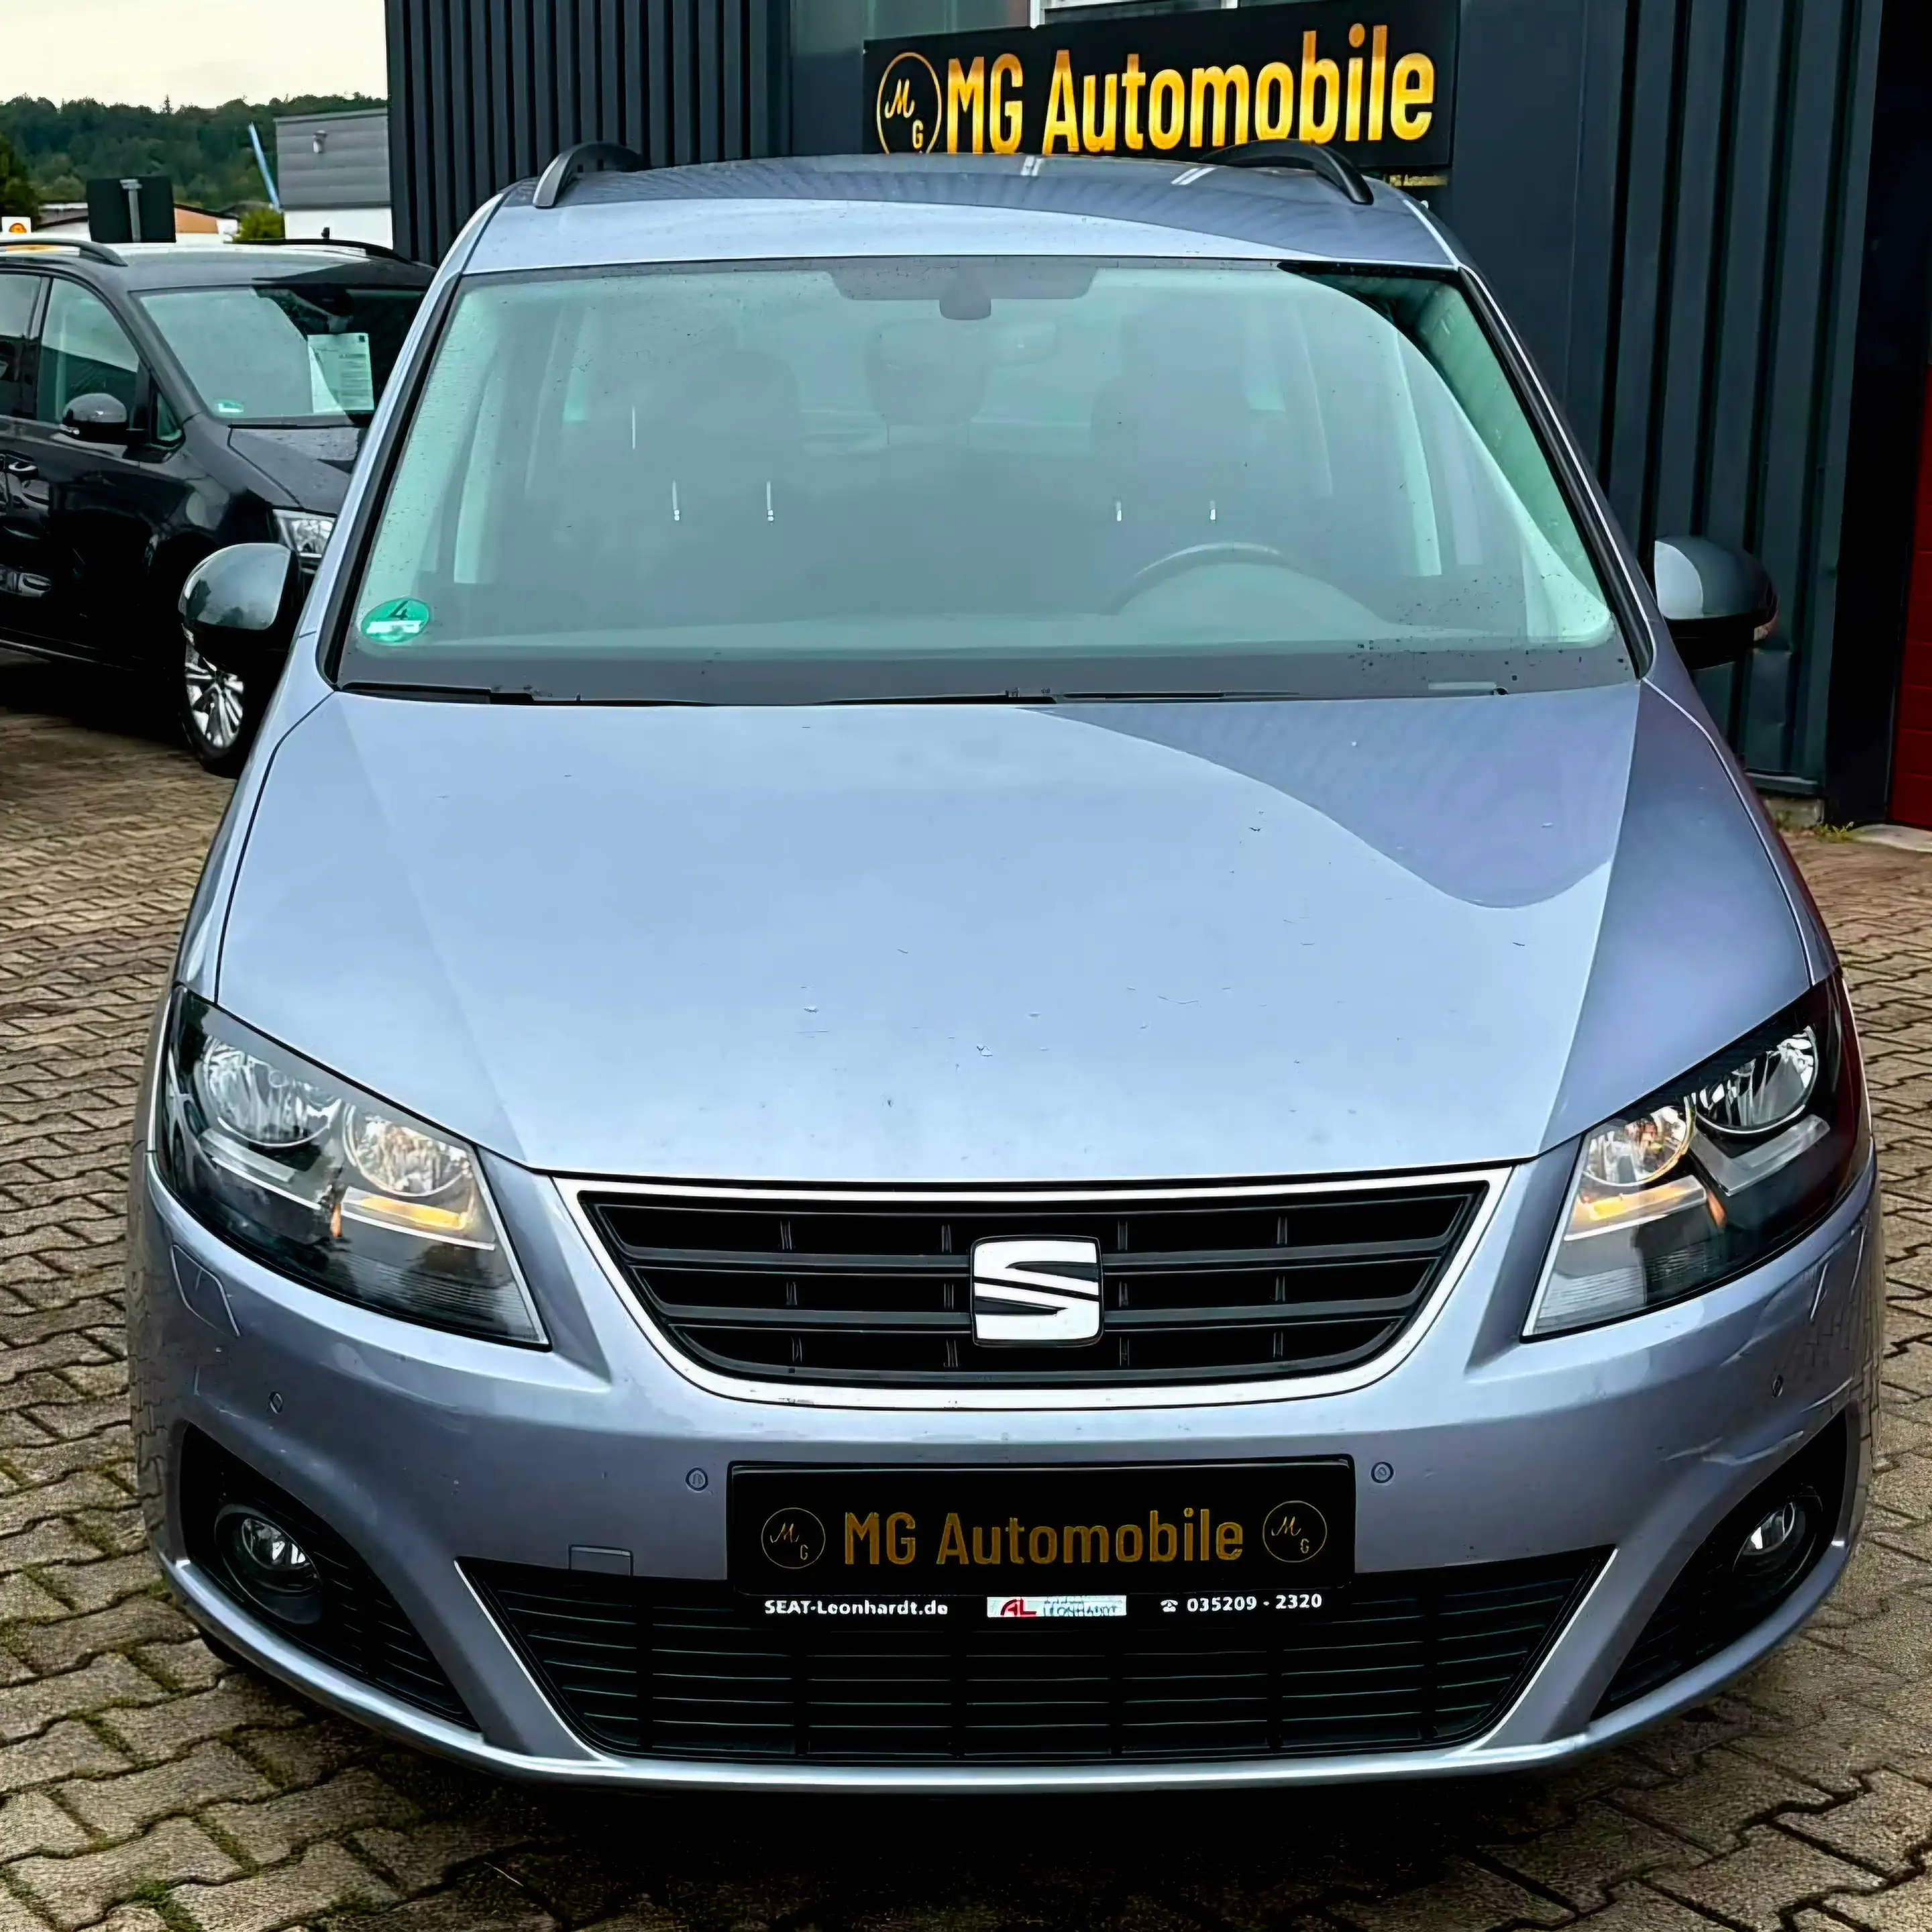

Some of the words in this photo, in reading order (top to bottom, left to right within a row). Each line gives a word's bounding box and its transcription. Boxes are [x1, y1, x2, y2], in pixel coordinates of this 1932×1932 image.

[947, 53, 1023, 154] MG
[1042, 23, 1434, 155] Automobile
[387, 600, 409, 620] 4
[845, 1511, 916, 1565] MG
[936, 1507, 1243, 1565] Automobile
[1187, 1596, 1257, 1612] 035209
[1275, 1593, 1322, 1609] 2320
